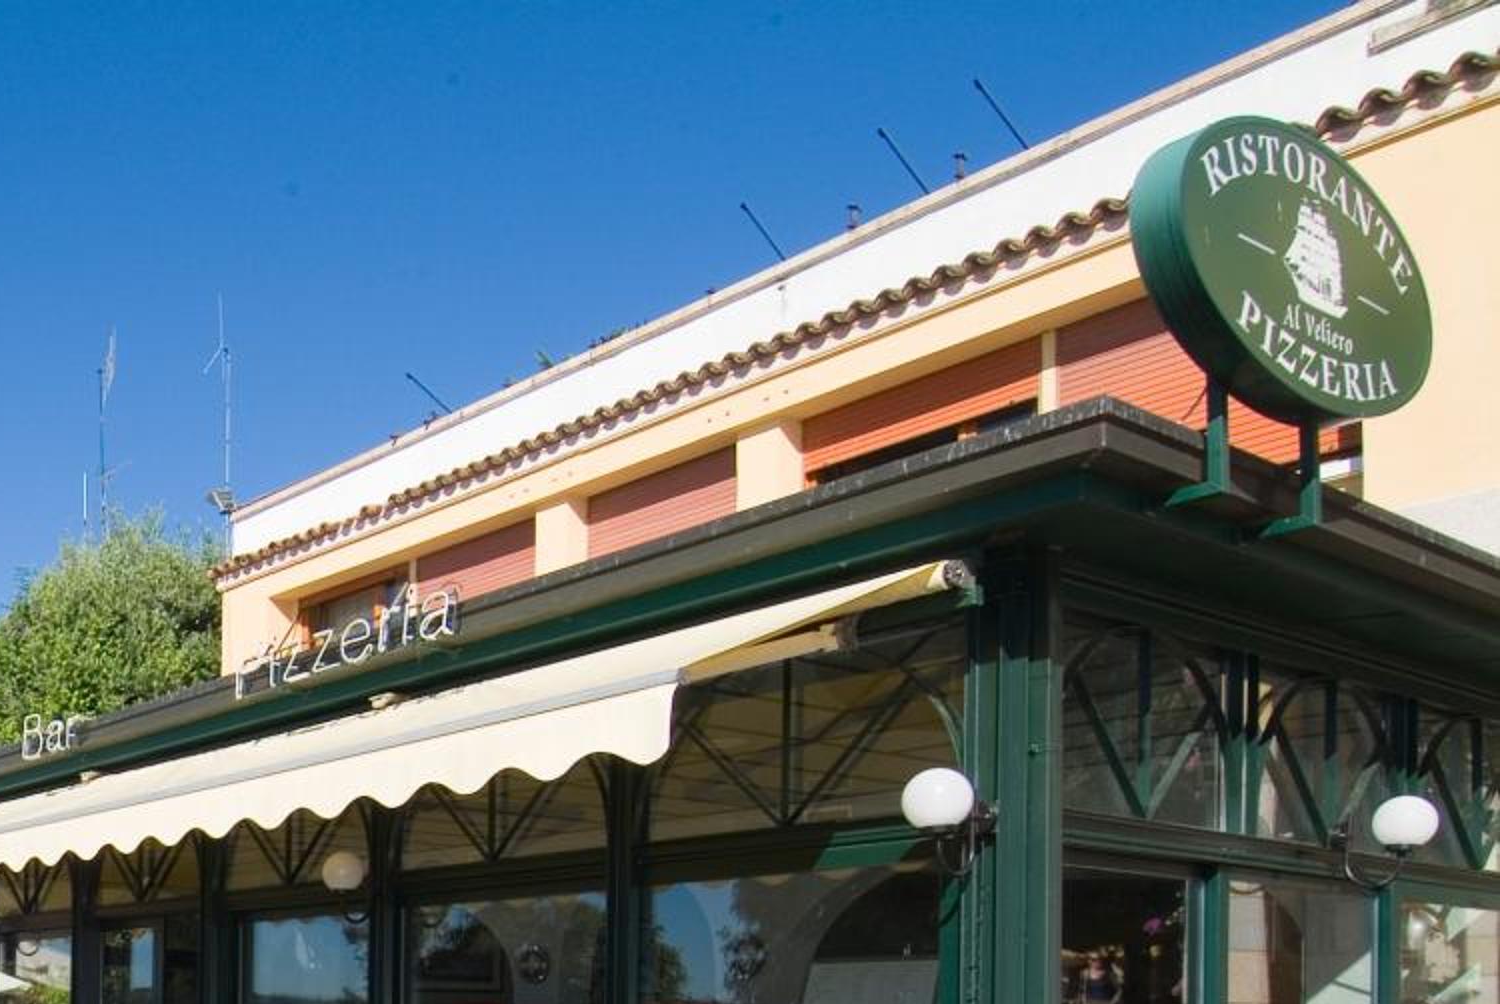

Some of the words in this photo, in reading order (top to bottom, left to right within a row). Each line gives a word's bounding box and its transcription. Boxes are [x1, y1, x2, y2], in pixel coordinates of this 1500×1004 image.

[1201, 133, 1413, 295] RISTORANTE
[1236, 290, 1398, 401] PIZZERIA
[1283, 303, 1300, 330] Al
[1304, 315, 1353, 354] Veliero
[21, 712, 91, 761] Bar
